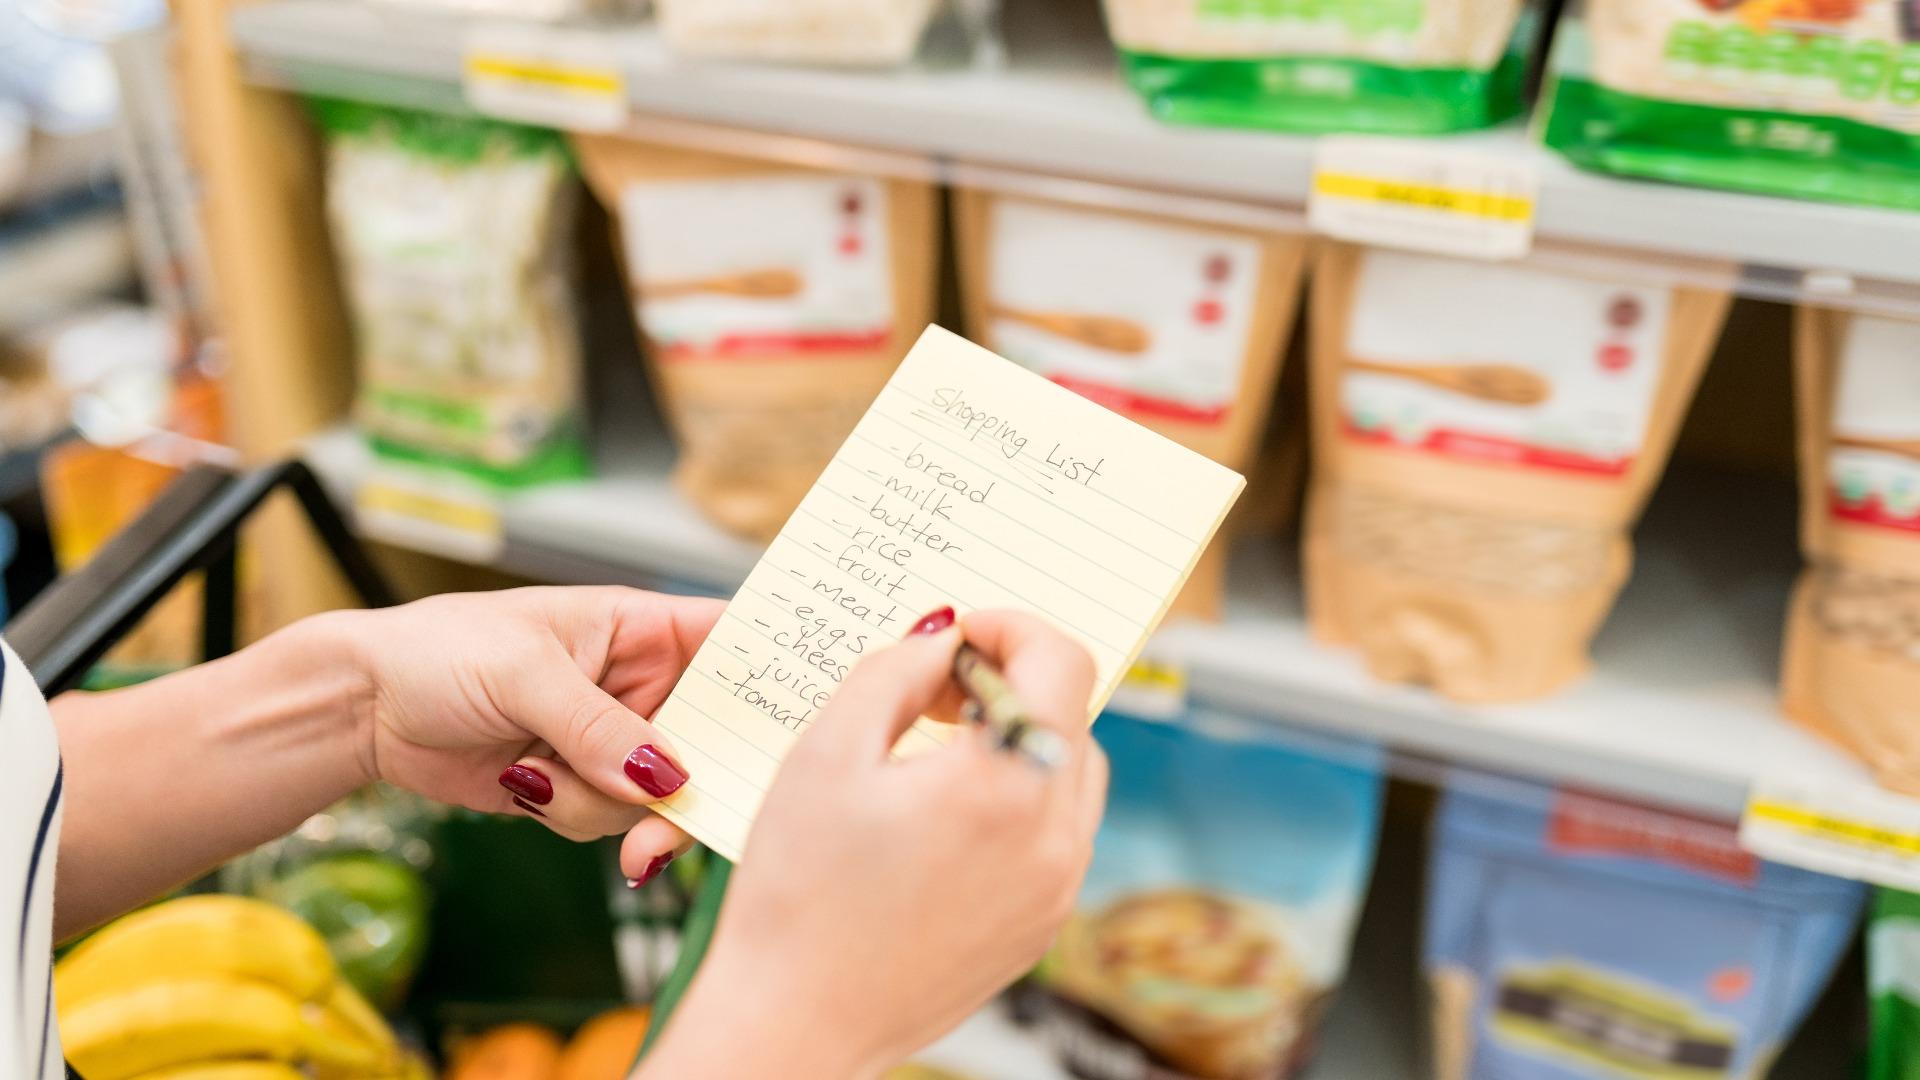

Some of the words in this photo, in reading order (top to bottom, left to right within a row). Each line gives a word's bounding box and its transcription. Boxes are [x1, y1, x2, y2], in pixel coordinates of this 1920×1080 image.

[932, 387, 1028, 459] Shopping
[1045, 443, 1105, 486] List
[884, 475, 953, 520] milk
[904, 442, 996, 503] bread
[852, 526, 912, 566] rice
[869, 494, 964, 552] butter
[837, 544, 907, 597] fruit
[812, 579, 897, 627] meat
[795, 606, 868, 654] eggs
[749, 657, 831, 710] juice
